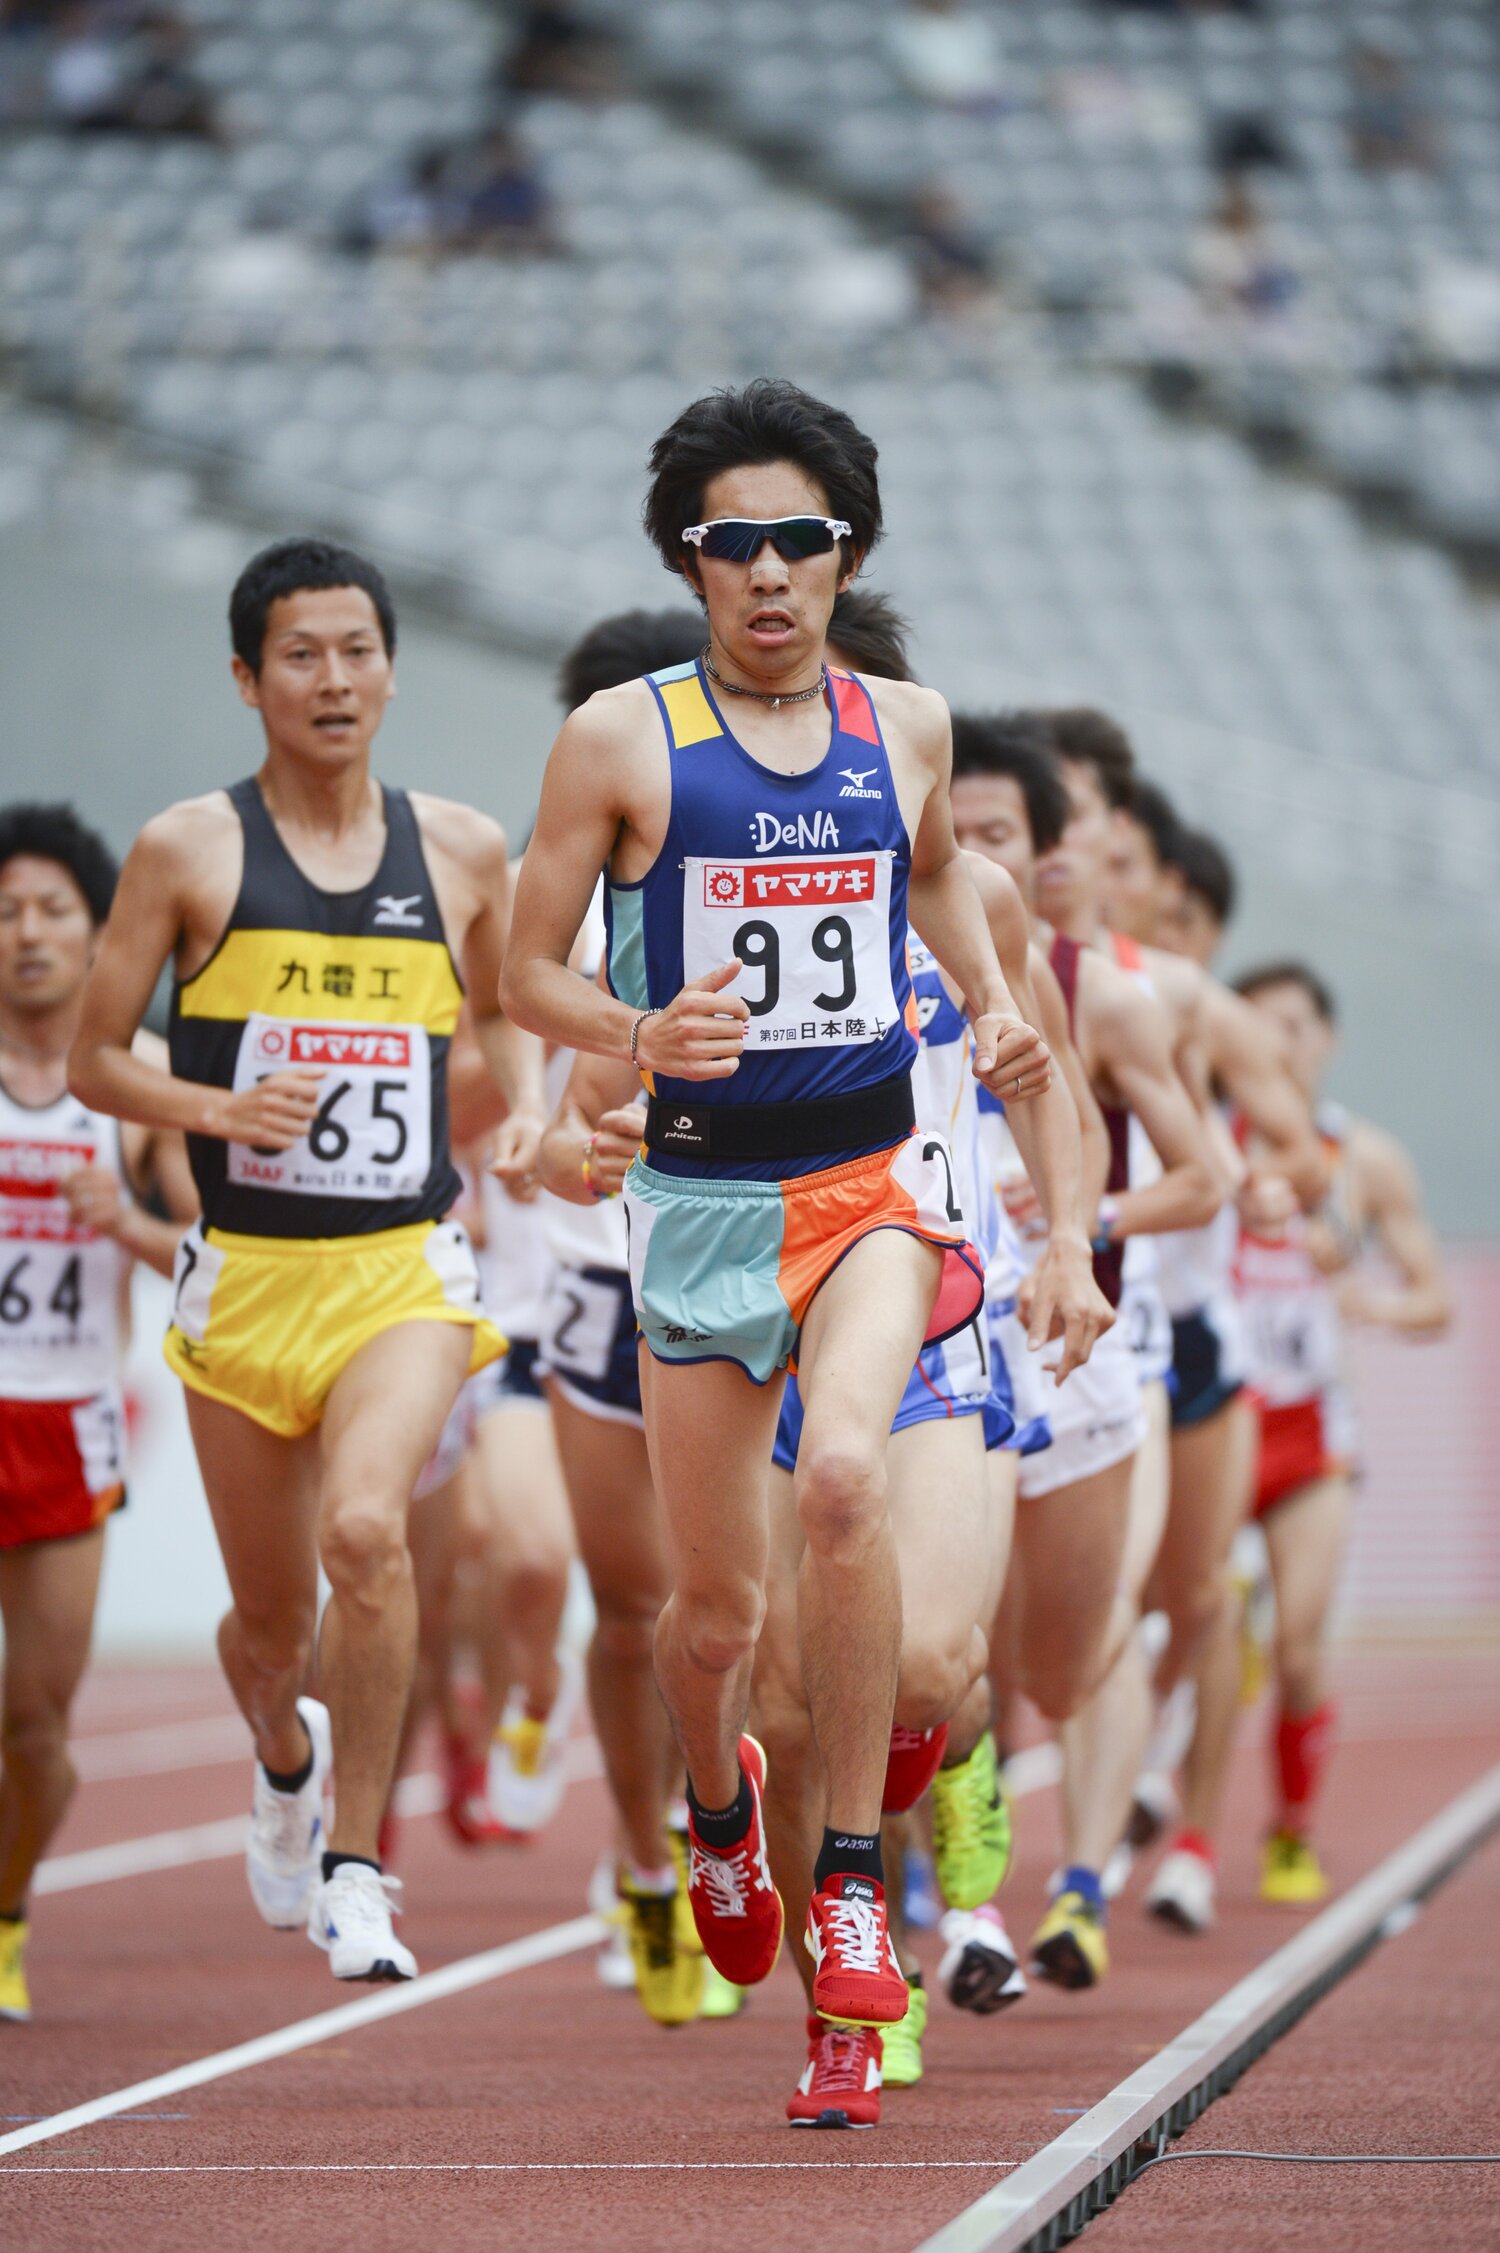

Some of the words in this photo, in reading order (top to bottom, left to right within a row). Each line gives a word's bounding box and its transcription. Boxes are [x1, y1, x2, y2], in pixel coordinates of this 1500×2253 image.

[751, 868, 869, 898] ヤマザキ
[277, 959, 403, 998] 九電工
[733, 915, 857, 1017] 99
[252, 1073, 408, 1165] 65
